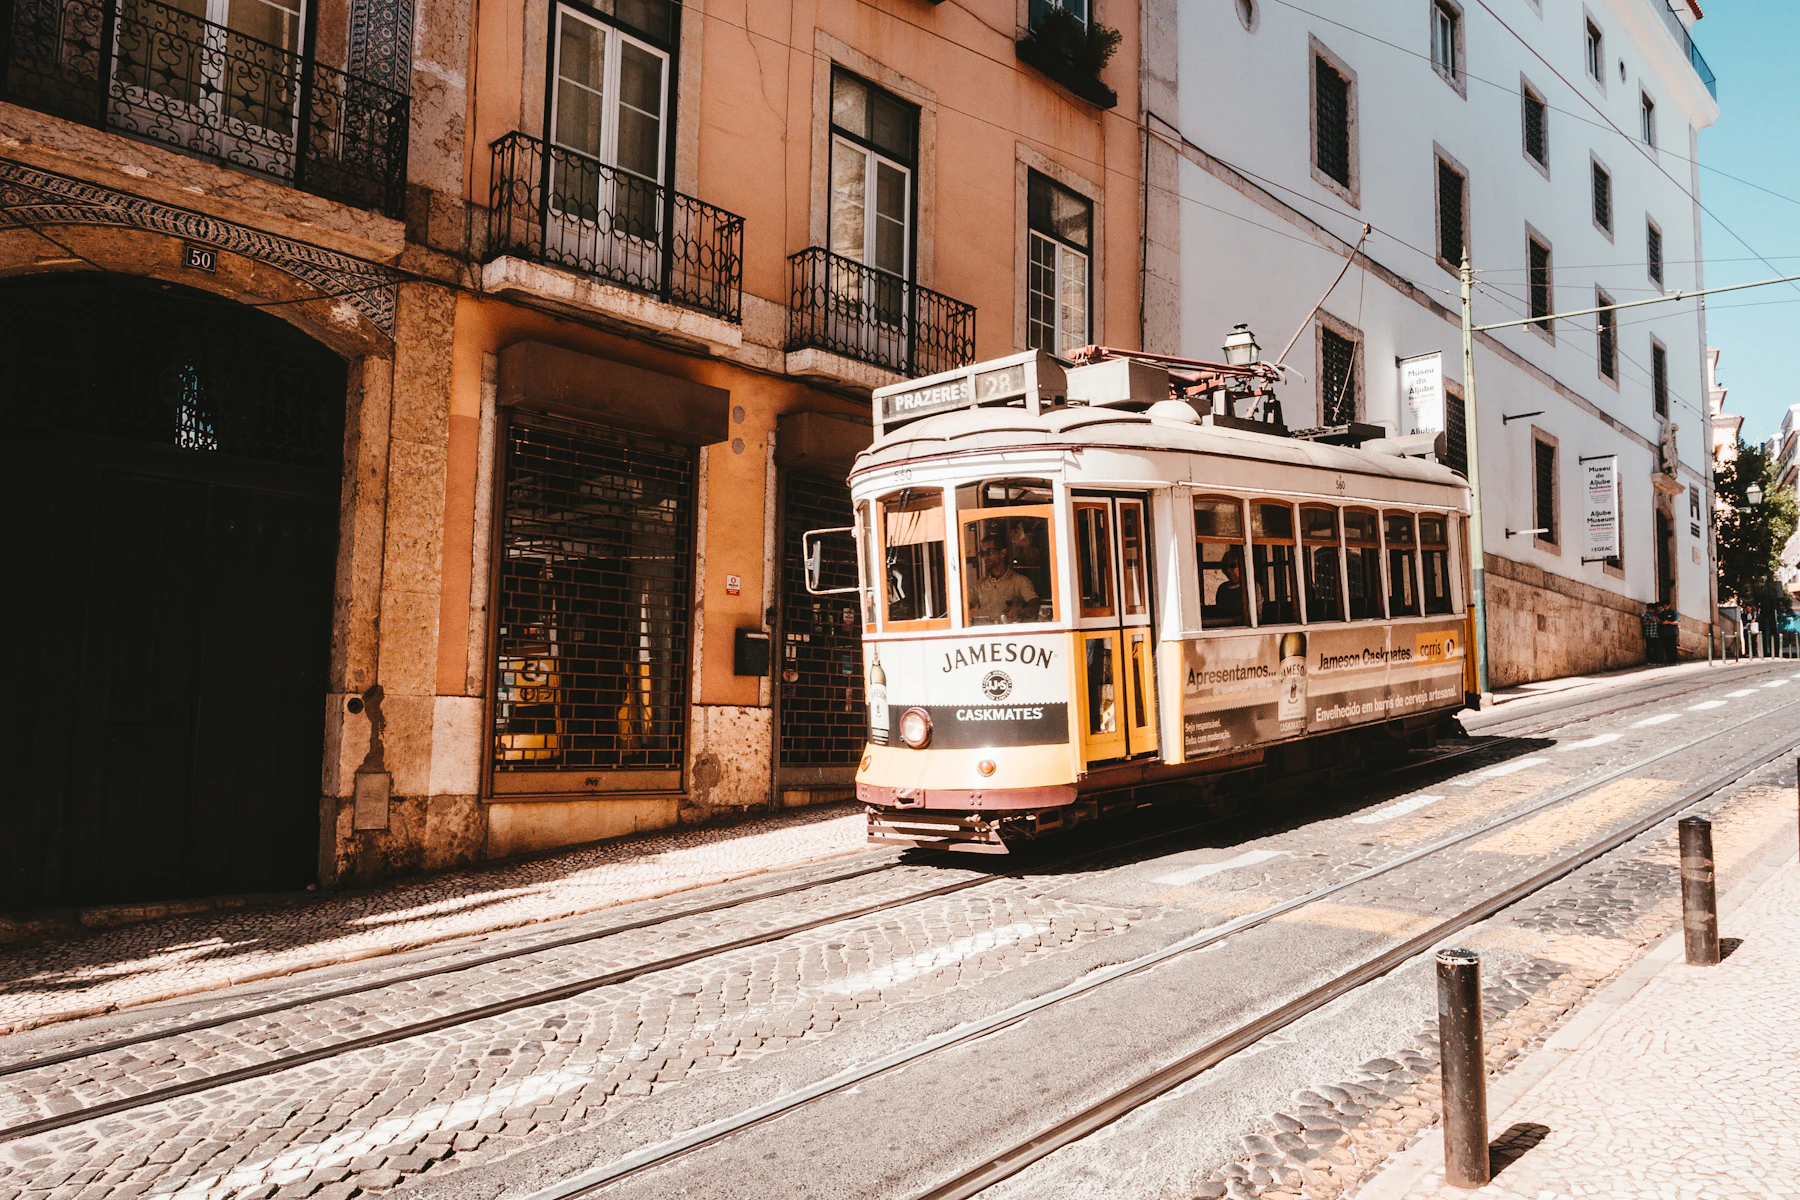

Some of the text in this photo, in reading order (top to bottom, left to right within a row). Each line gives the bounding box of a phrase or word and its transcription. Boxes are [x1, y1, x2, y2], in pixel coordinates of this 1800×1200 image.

[191, 250, 211, 268] 50
[1408, 368, 1435, 377] Museu
[985, 372, 1012, 397] 28
[1409, 386, 1435, 395] Aljube
[895, 384, 969, 411] PRAZERES
[894, 469, 912, 482] 560
[1590, 479, 1611, 487] Aljube
[1336, 480, 1345, 490] 560
[1420, 640, 1441, 656] carris
[942, 643, 1054, 673] JAMESON
[1318, 646, 1412, 671] Jameson Caskmates.
[1187, 664, 1277, 690] Apresentamos...
[1280, 664, 1307, 683] JAMESO
[1316, 704, 1361, 722] Envelhecido
[1362, 703, 1373, 713] em
[1374, 698, 1393, 712] barris
[1395, 696, 1403, 708] de
[1405, 691, 1428, 707] cerveja
[1429, 685, 1457, 701] artesanal.
[956, 708, 1043, 722] CASKMATES
